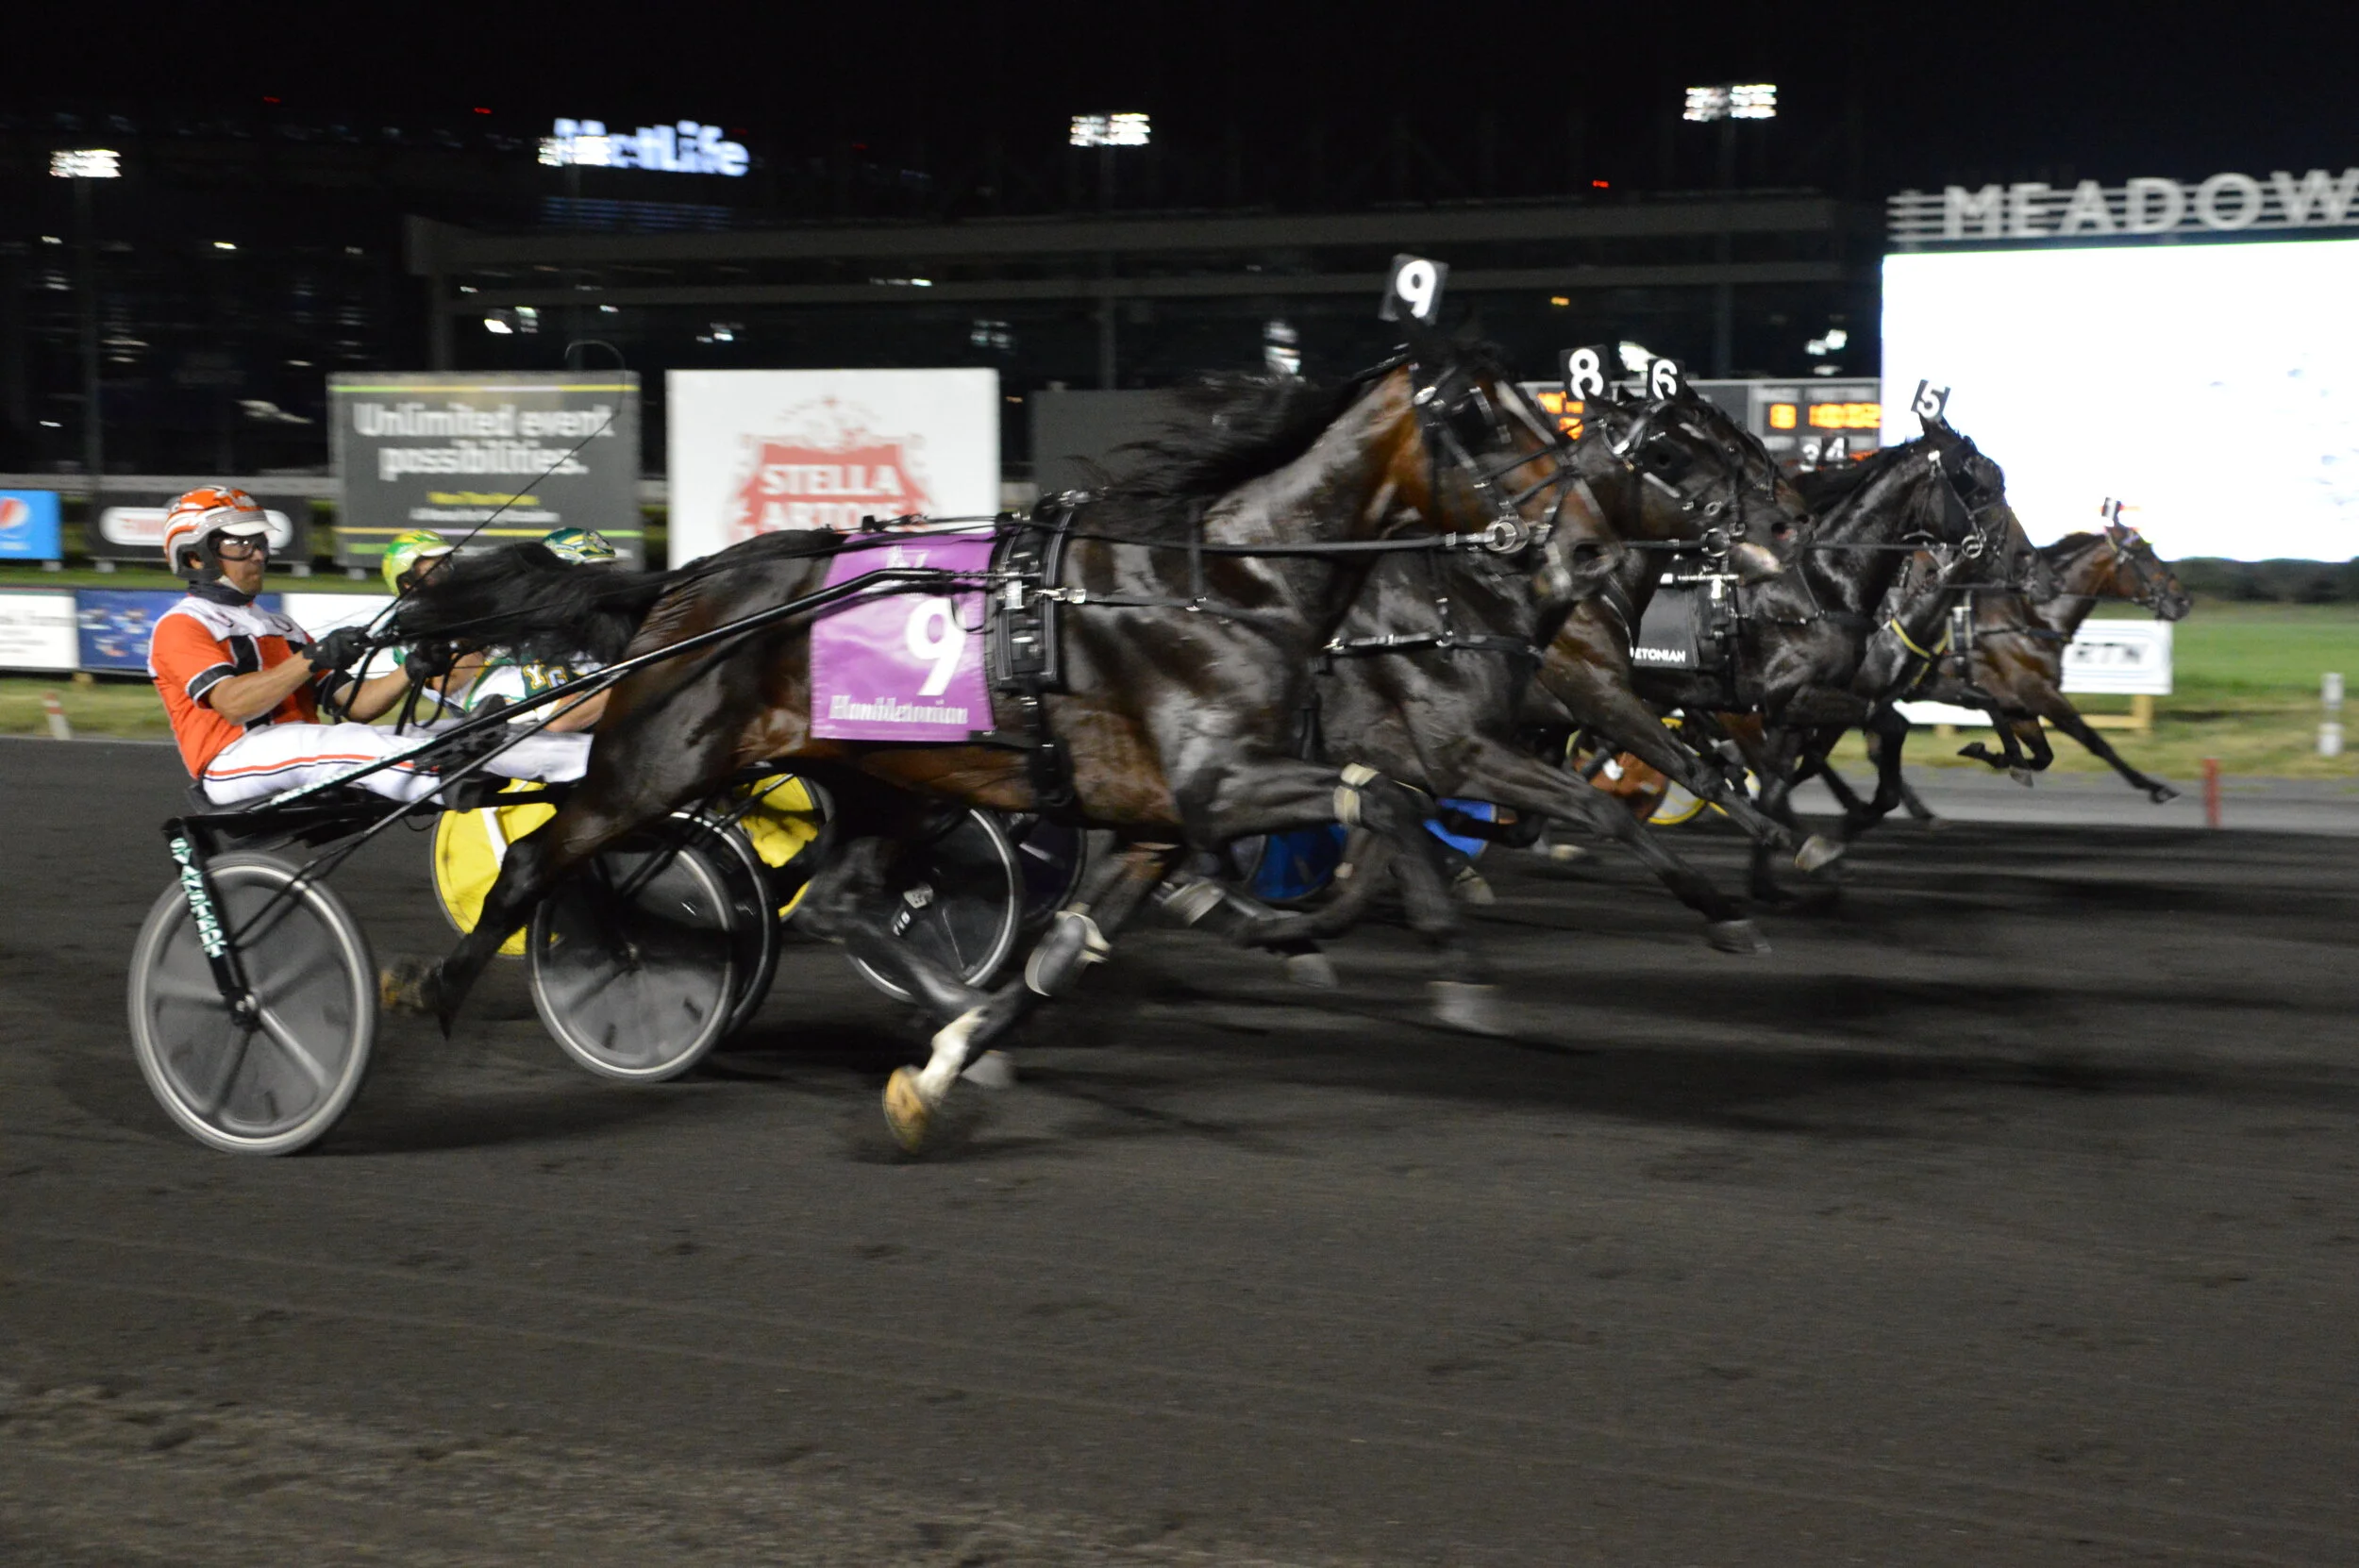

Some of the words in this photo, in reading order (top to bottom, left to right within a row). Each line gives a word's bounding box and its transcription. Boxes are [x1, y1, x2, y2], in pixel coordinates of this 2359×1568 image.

[1942, 167, 2359, 240] MEADOW
[1396, 259, 1437, 319] 9
[1569, 348, 1604, 400] 8
[1652, 359, 1678, 401] 6
[353, 402, 516, 436] Unlimited
[519, 404, 615, 437] event
[1916, 380, 1946, 420] 5
[761, 464, 903, 495] STELLA
[906, 597, 966, 696] 9
